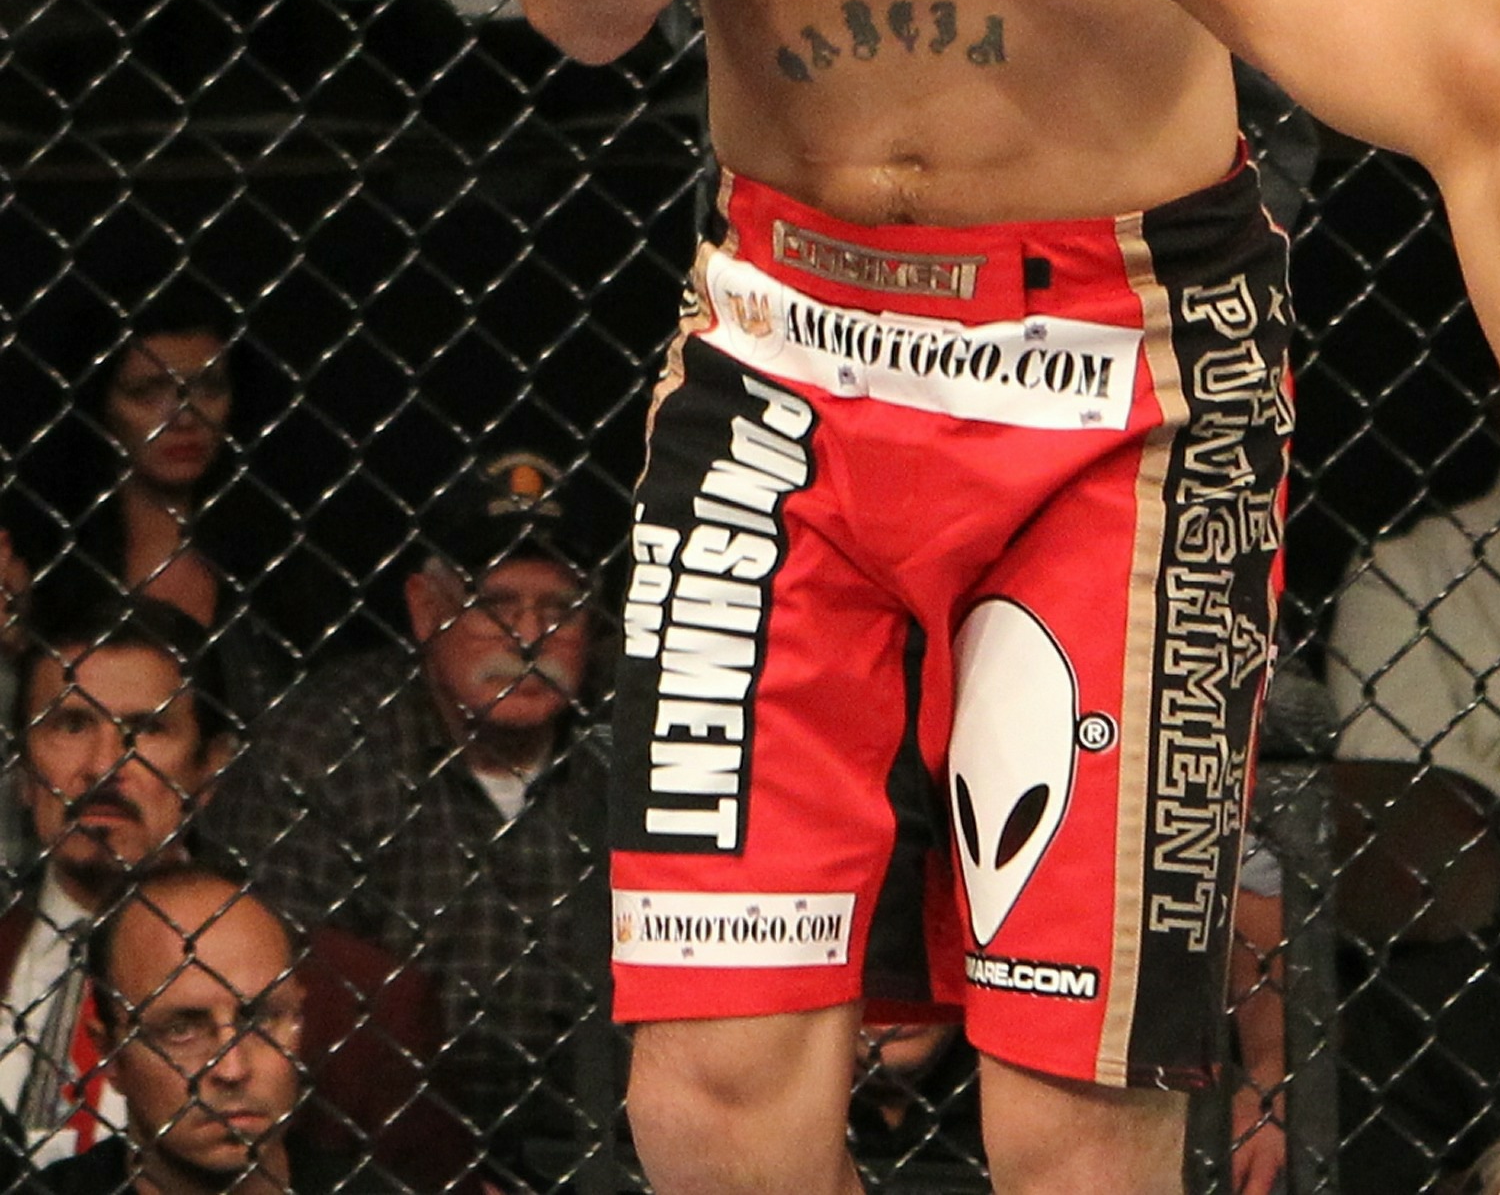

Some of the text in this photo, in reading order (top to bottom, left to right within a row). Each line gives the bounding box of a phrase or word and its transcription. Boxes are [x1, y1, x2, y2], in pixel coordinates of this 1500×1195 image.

[784, 302, 1116, 400] AMMOTOGO.COM
[645, 374, 815, 850] PUNISHMENT
[1149, 274, 1267, 952] PUNISHMENT
[639, 914, 842, 944] AMMOTOGO.COM
